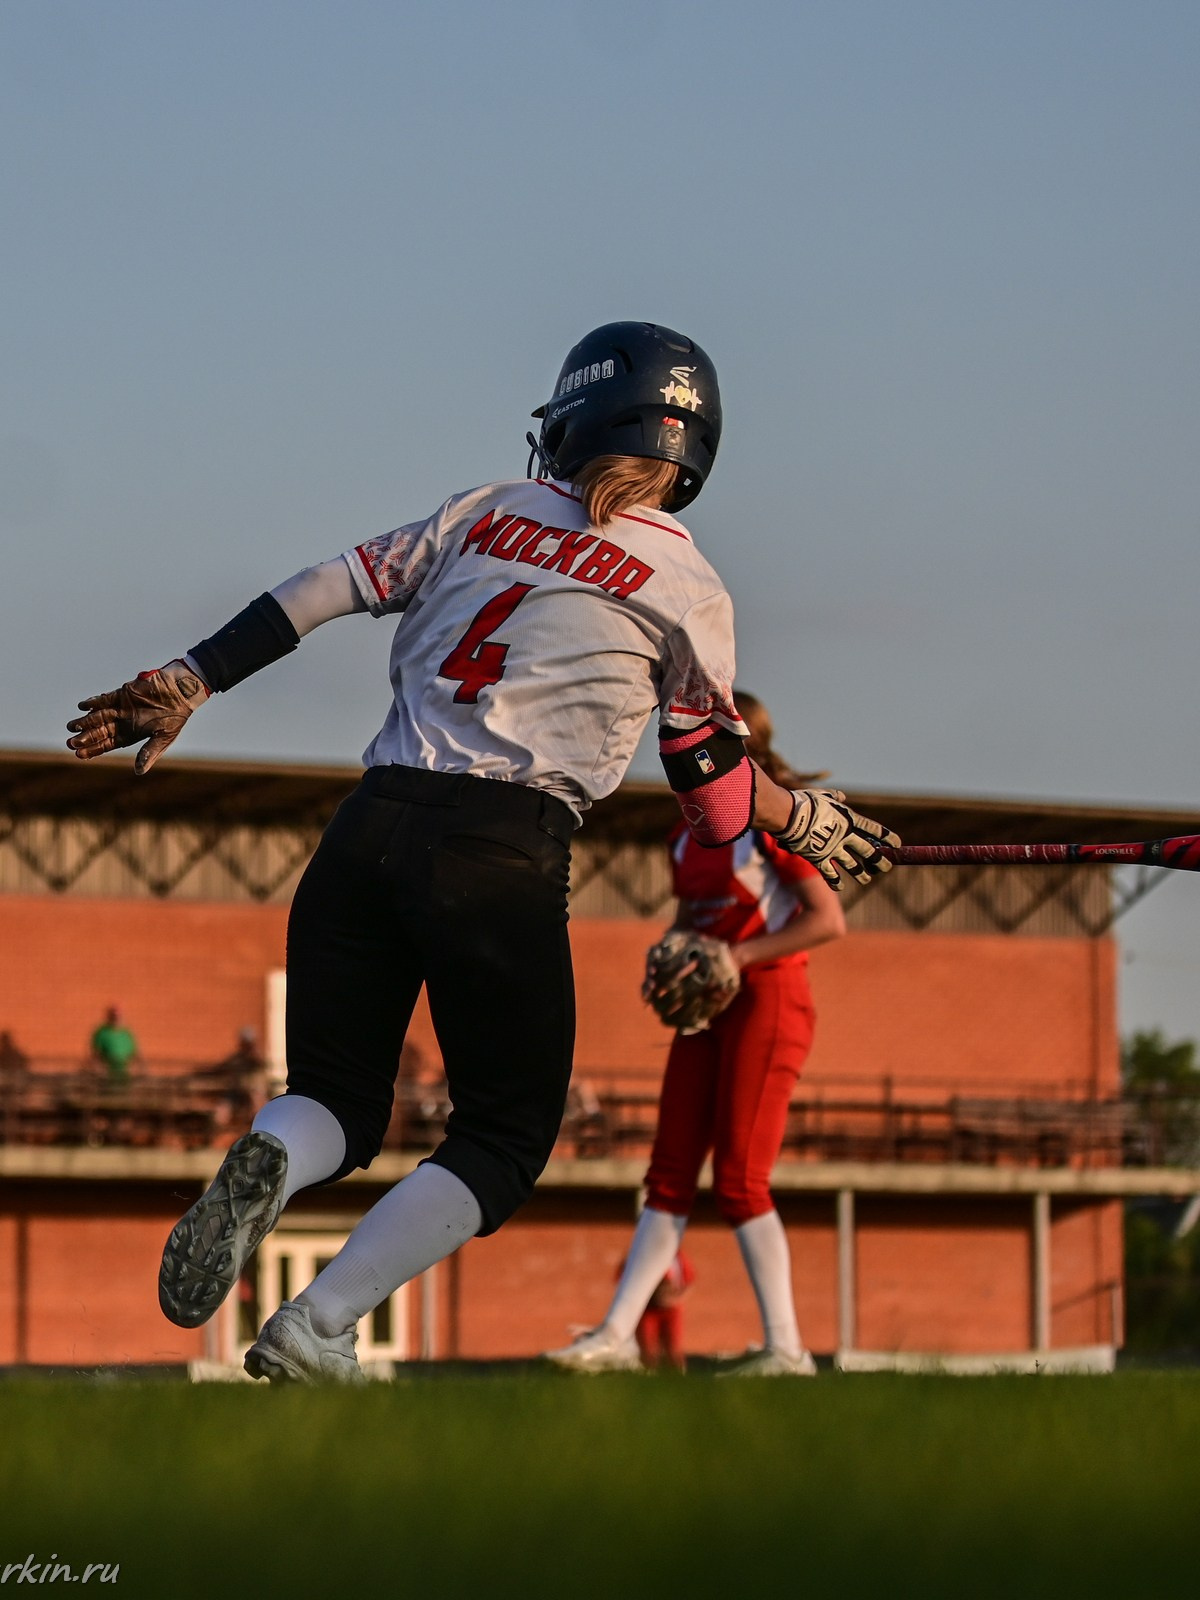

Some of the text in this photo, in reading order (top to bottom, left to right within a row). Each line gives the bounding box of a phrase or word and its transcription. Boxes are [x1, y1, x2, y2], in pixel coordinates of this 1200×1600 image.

[556, 398, 586, 416] EASTON
[459, 508, 656, 601] МОСКВА
[438, 581, 540, 704] 4
[1095, 847, 1135, 856] LOUISVILLE
